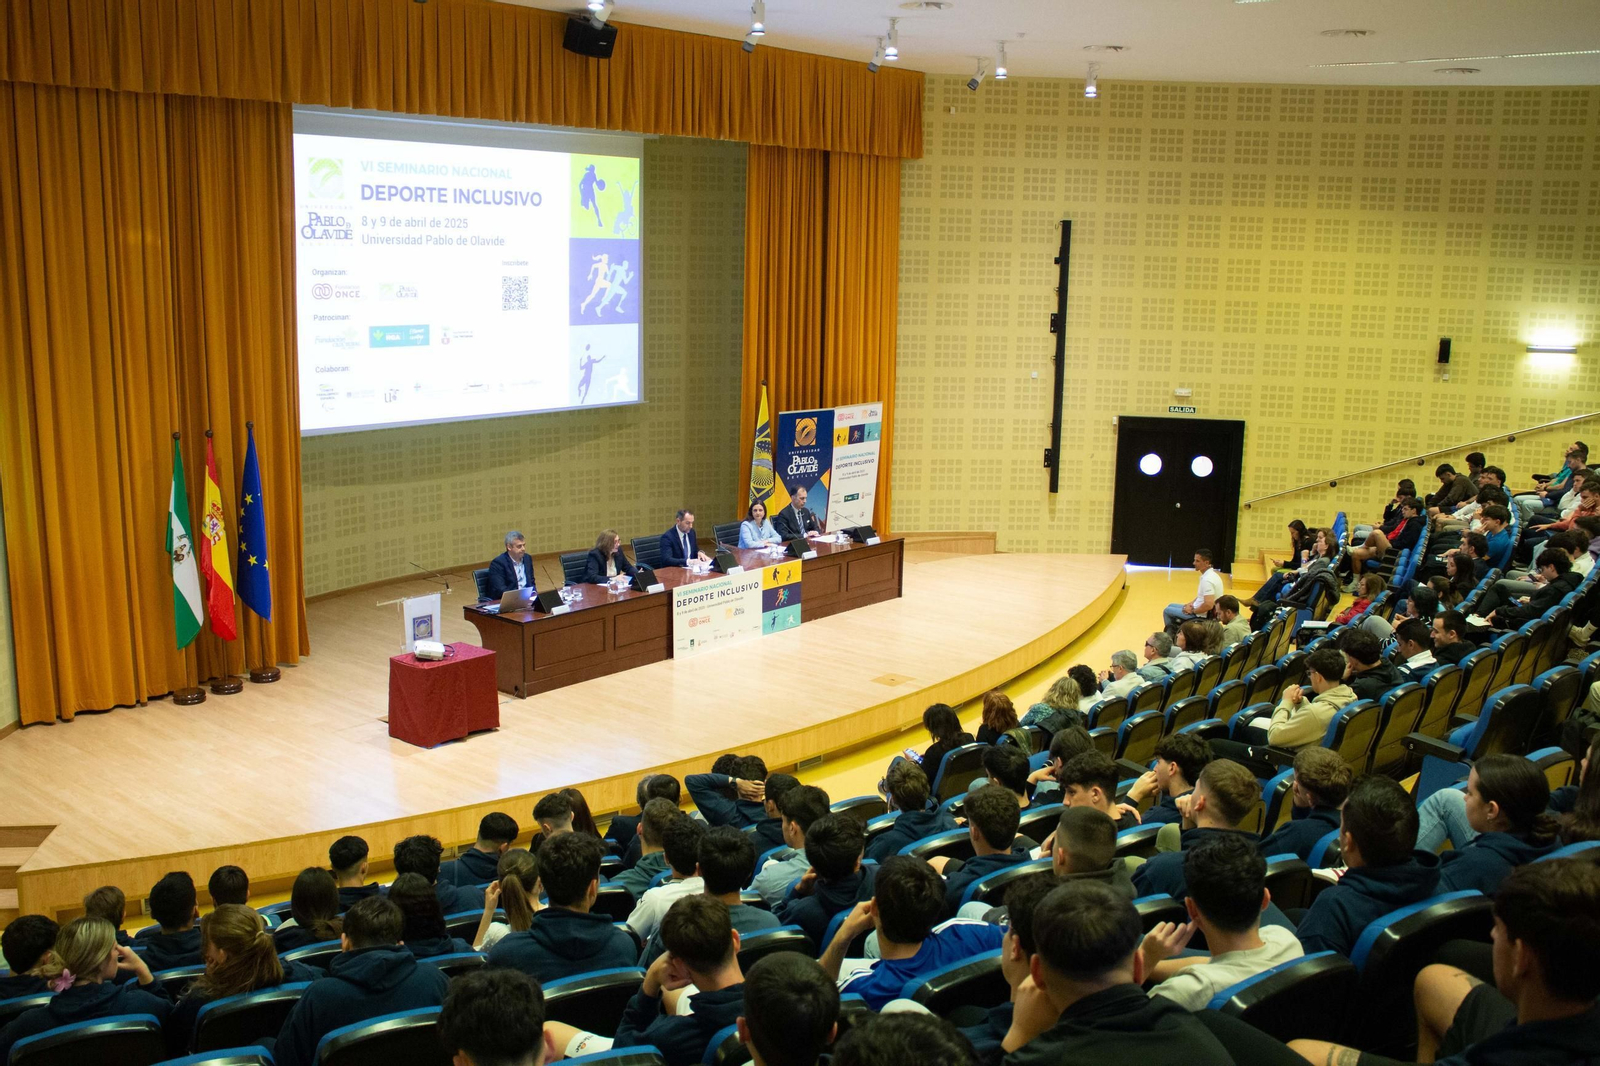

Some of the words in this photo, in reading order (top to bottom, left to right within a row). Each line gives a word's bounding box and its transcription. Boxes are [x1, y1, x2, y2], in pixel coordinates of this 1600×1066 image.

[360, 160, 373, 172] VI
[377, 162, 448, 176] SEMINARIO
[452, 166, 512, 180] NACIONAL
[360, 184, 448, 204] DEPORTE
[453, 188, 542, 207] INCLUSIVO
[308, 212, 346, 227] PABLO
[361, 216, 368, 226] 8
[371, 218, 377, 229] y
[380, 216, 386, 227] 9
[389, 216, 402, 228] de
[404, 216, 426, 228] abril
[430, 218, 442, 228] de
[444, 218, 468, 228] 2025
[300, 225, 354, 240] OLAVIDE
[361, 234, 422, 246] Universidad
[426, 234, 454, 246] Pablo
[456, 235, 468, 246] de
[470, 236, 505, 246] Olavide
[312, 268, 348, 277] Organizan:
[335, 290, 360, 298] ONCE
[792, 456, 814, 466] PABLO
[836, 462, 853, 470] DEPORTE
[854, 458, 875, 466] INCLUSIVO
[788, 464, 818, 475] OLAVIDE
[682, 586, 708, 596] SEMINARIO
[710, 580, 732, 590] NACIONAL
[676, 592, 714, 608] DEPORTE
[718, 582, 760, 598] INCLUSIVO
